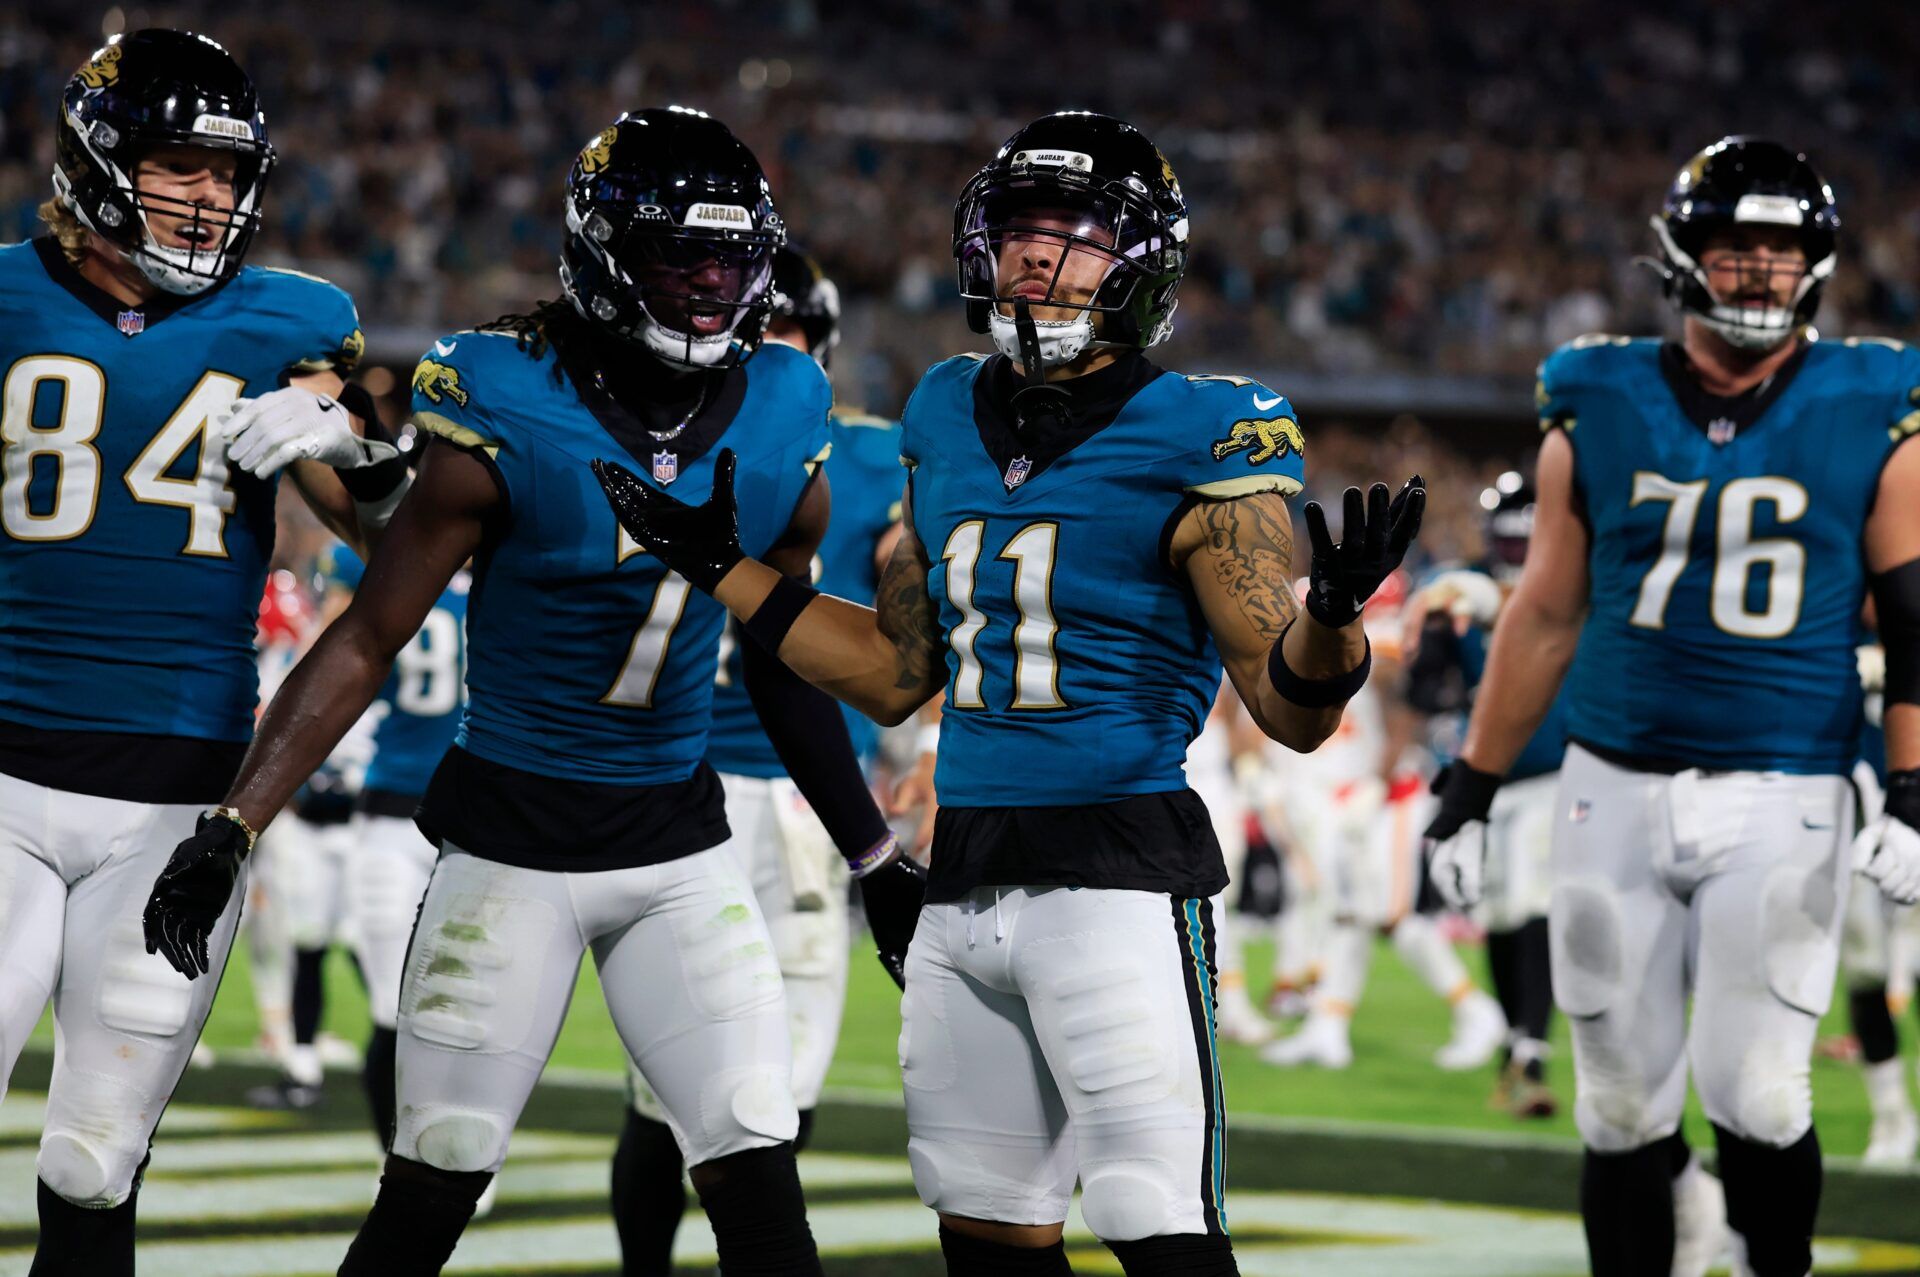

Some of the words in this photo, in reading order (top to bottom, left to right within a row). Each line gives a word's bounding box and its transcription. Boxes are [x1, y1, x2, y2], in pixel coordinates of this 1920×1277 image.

[696, 206, 745, 222] JAGUARS
[0, 354, 247, 557] 84
[656, 465, 675, 479] NFL
[600, 521, 692, 708] 7
[941, 519, 1068, 709] 11
[1628, 469, 1808, 638] 76
